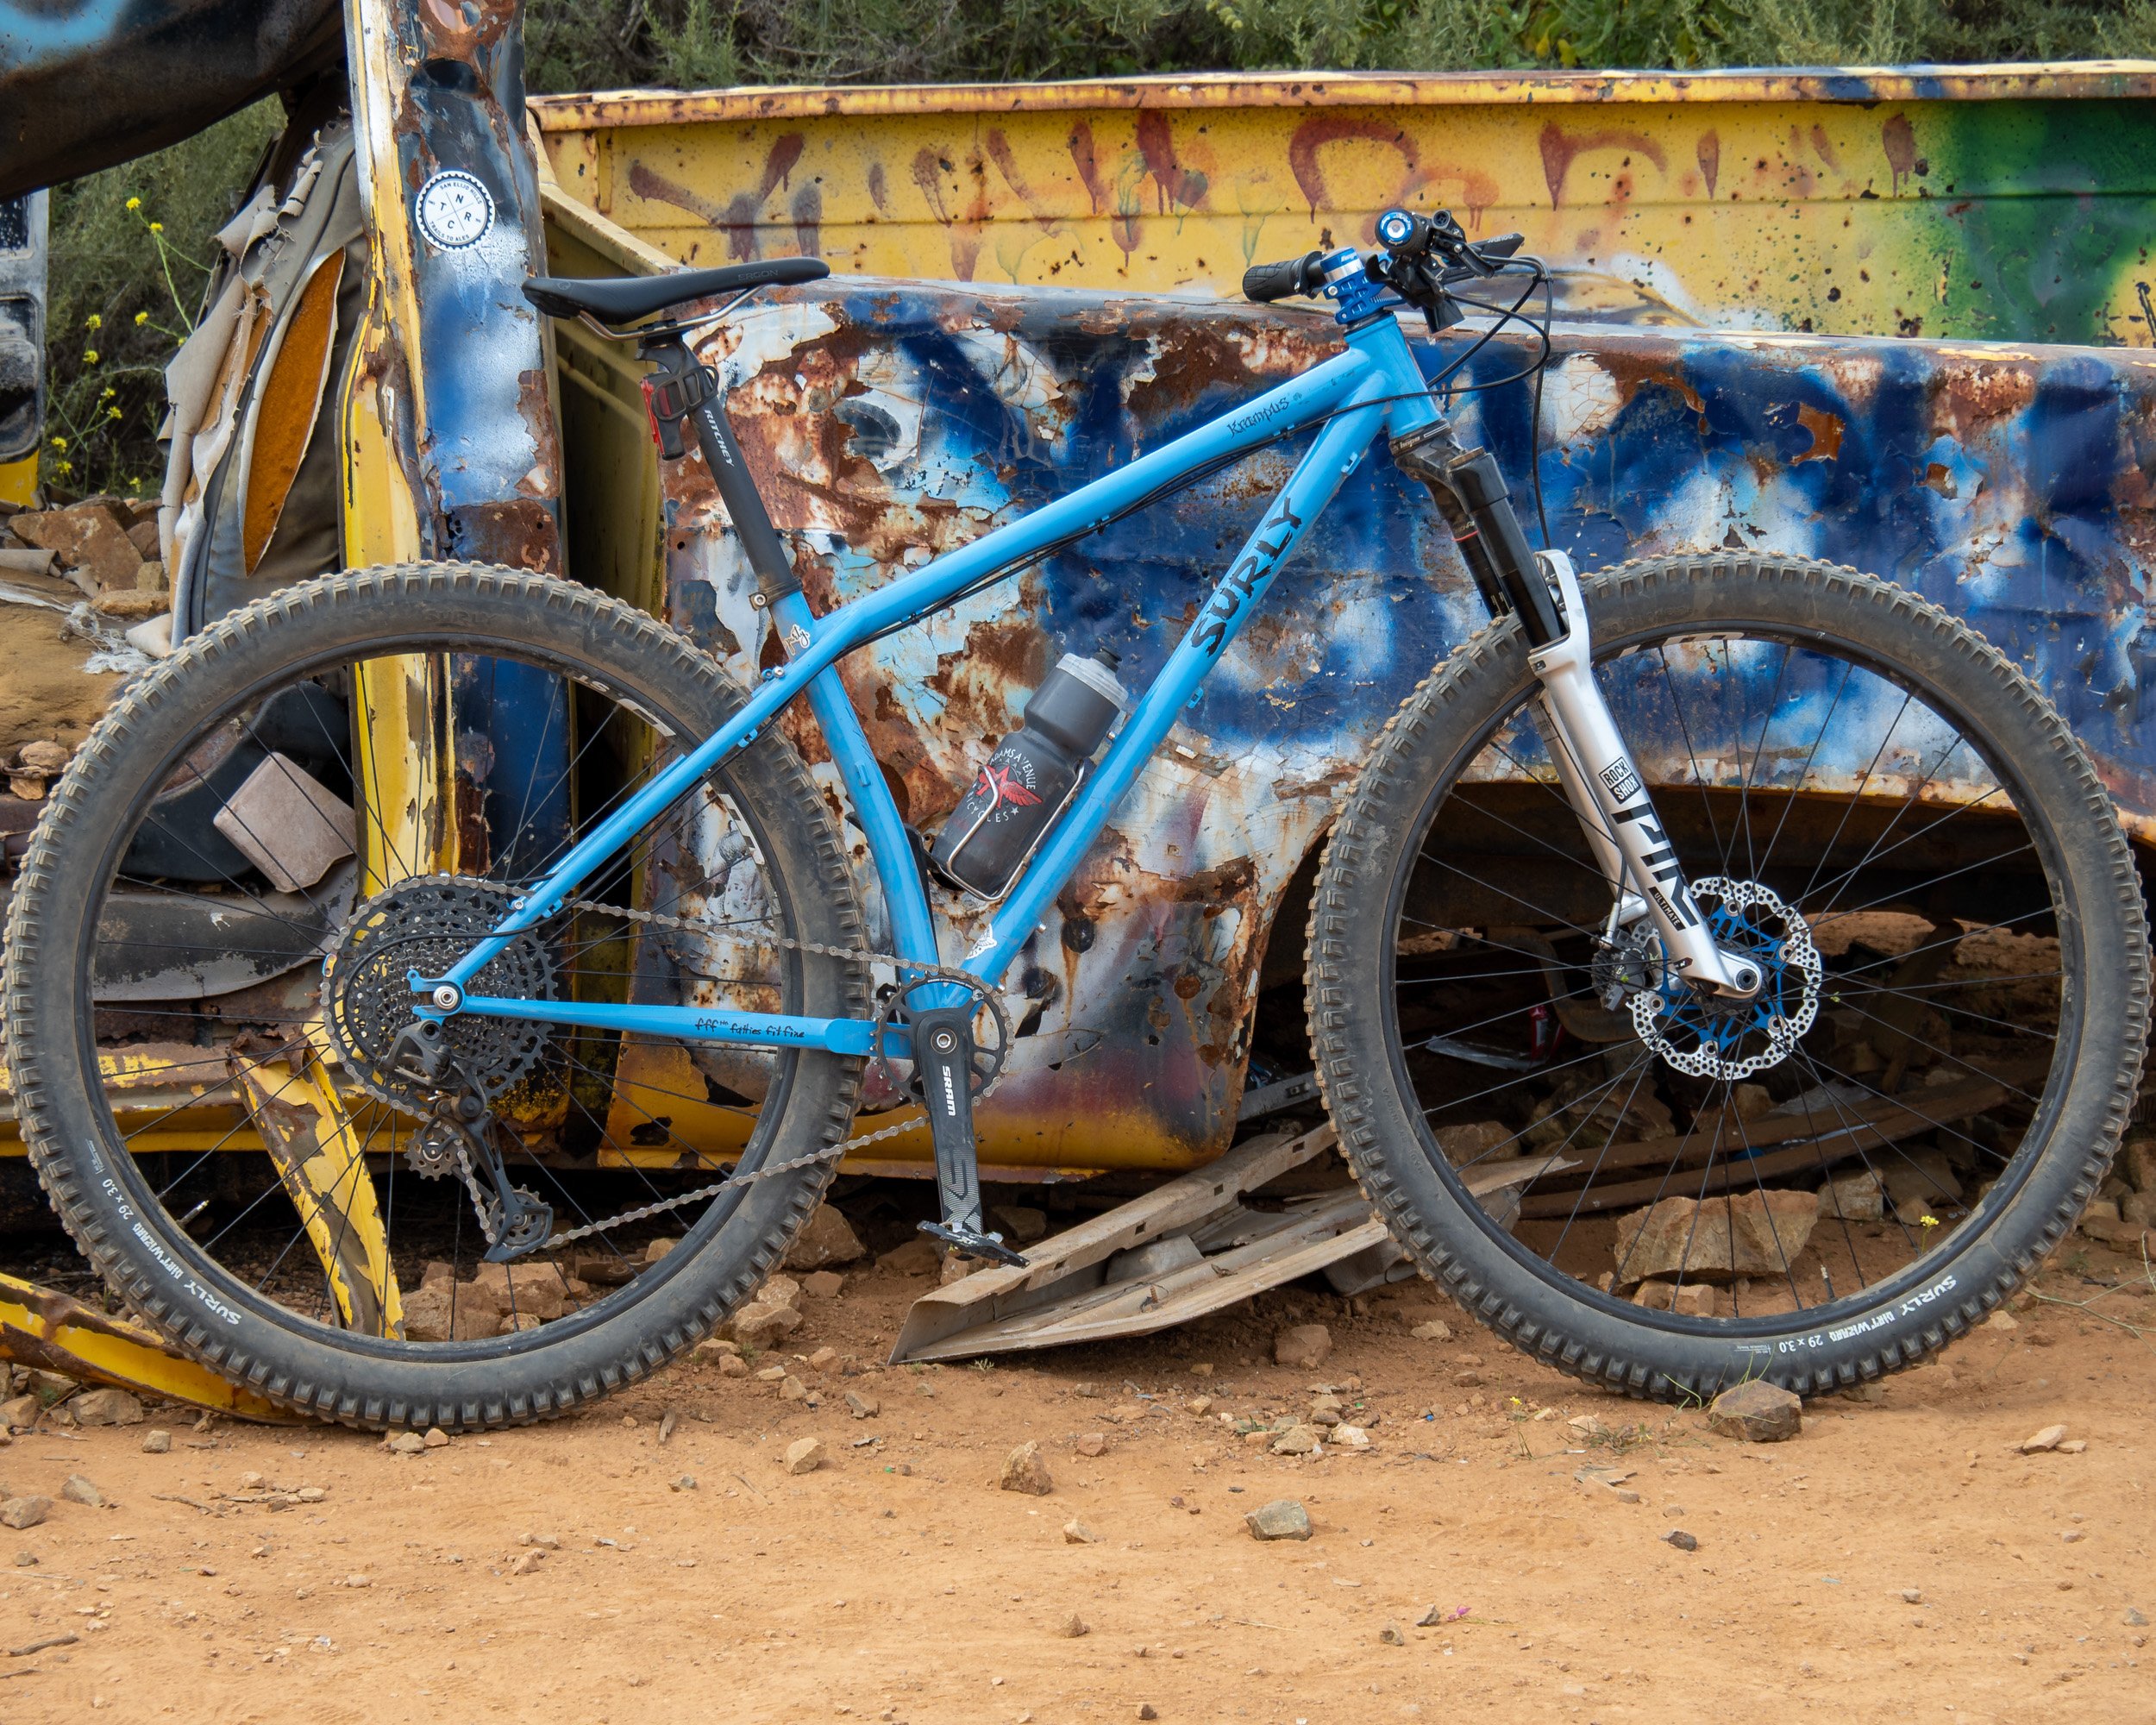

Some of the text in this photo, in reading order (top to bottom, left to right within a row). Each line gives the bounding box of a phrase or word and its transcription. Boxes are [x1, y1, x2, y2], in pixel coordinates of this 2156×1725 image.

[440, 202, 447, 211] T
[455, 194, 464, 204] N
[448, 220, 455, 229] C
[464, 211, 472, 222] R
[737, 269, 779, 281] ERGON
[1226, 397, 1289, 439] Krampus
[704, 410, 735, 467] RITCHEY
[1190, 496, 1302, 658] SURLY
[1603, 761, 1629, 786] ROCK
[1613, 774, 1639, 800] SHOX
[1653, 892, 1681, 926] ULTIMATE
[730, 1023, 761, 1036] fatties
[942, 1064, 956, 1117] SRAM
[102, 1178, 118, 1198] 3.0
[118, 1204, 135, 1220] 29
[183, 1279, 242, 1326] SURLY
[1901, 1275, 1958, 1316] SURLY
[1778, 1339, 1796, 1354] 3.0
[1808, 1334, 1824, 1348] 29
